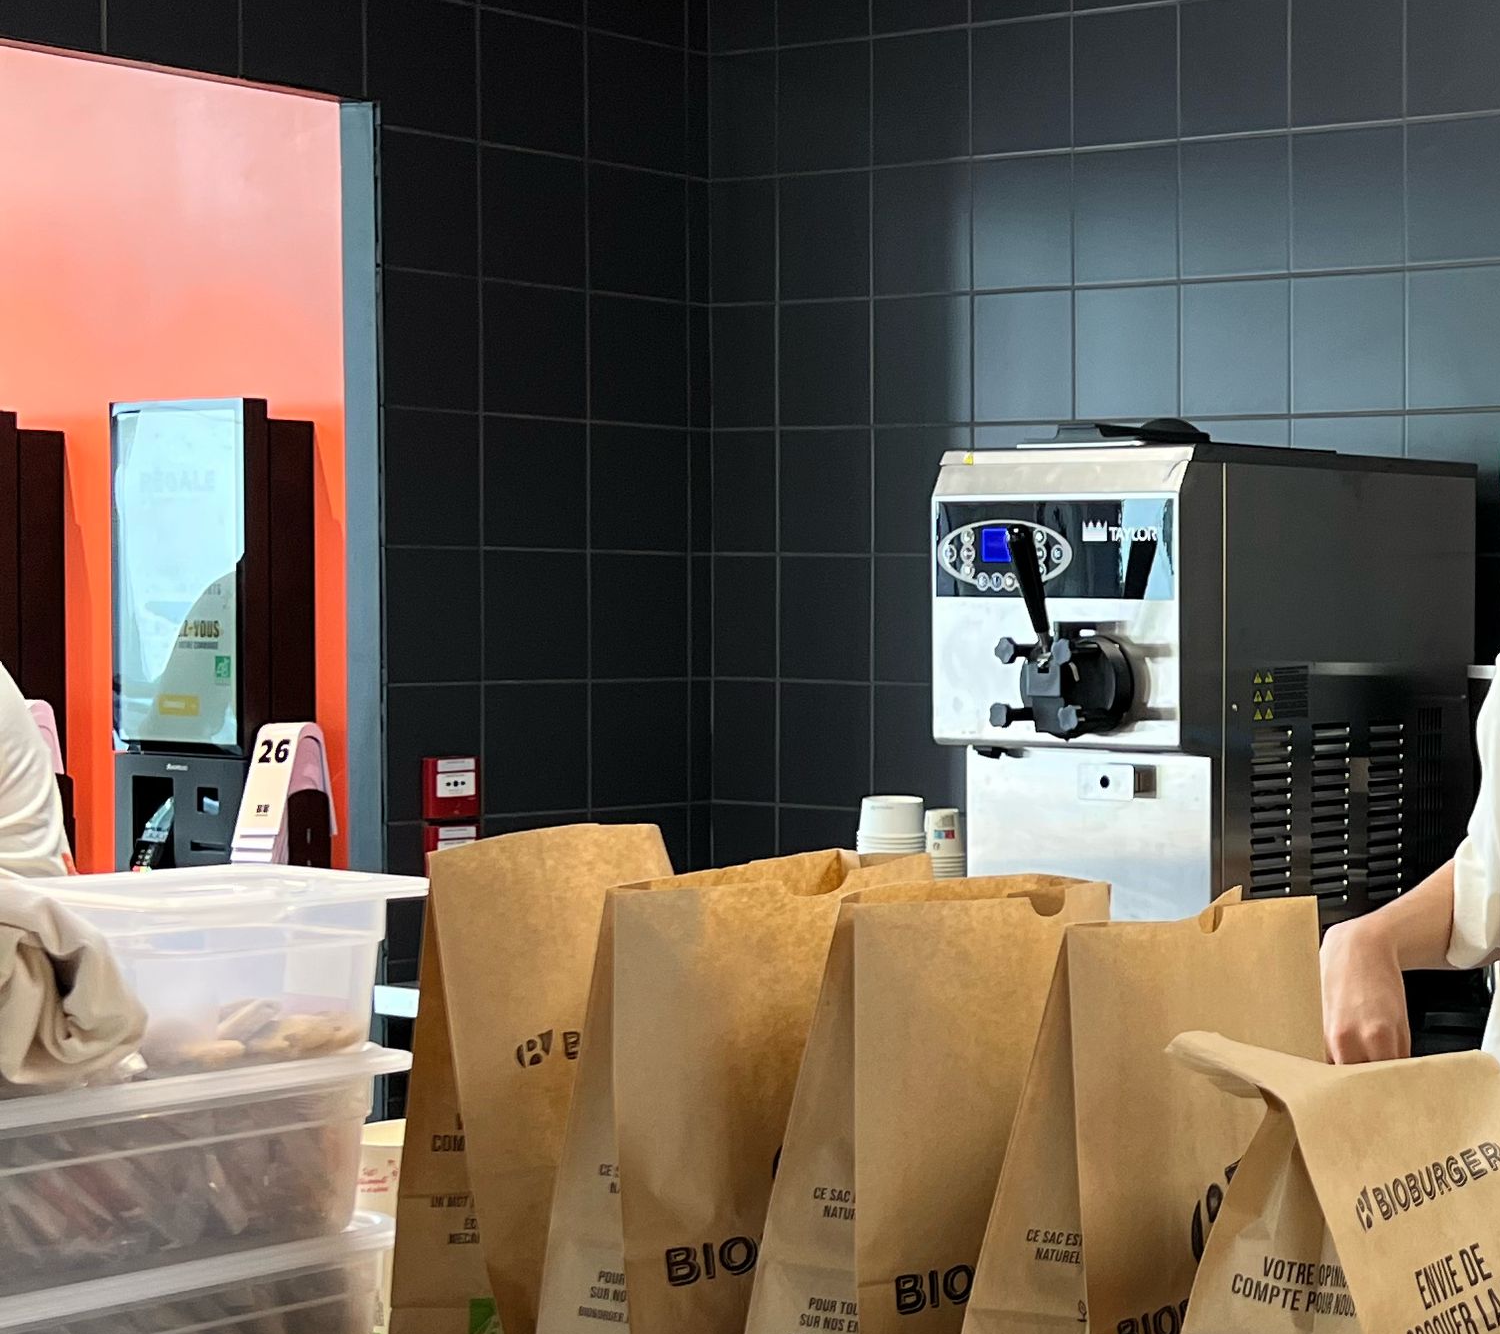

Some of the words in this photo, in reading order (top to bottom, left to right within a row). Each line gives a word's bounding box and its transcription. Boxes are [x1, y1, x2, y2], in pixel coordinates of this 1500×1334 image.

[1109, 527, 1158, 542] TAYLOR
[258, 739, 291, 763] 26
[814, 1187, 827, 1201] CE
[829, 1188, 851, 1203] SAC
[1026, 1229, 1040, 1243] CE
[1042, 1231, 1063, 1245] SAC
[1034, 1247, 1081, 1265] NATUREL
[1263, 1256, 1315, 1286] VOTRE
[1415, 1255, 1464, 1310] ENVIE
[1459, 1243, 1493, 1287] DE
[1231, 1273, 1302, 1312] COMPTE
[808, 1297, 837, 1314] POUR
[800, 1313, 820, 1329] SUR
[823, 1316, 844, 1332] NOS
